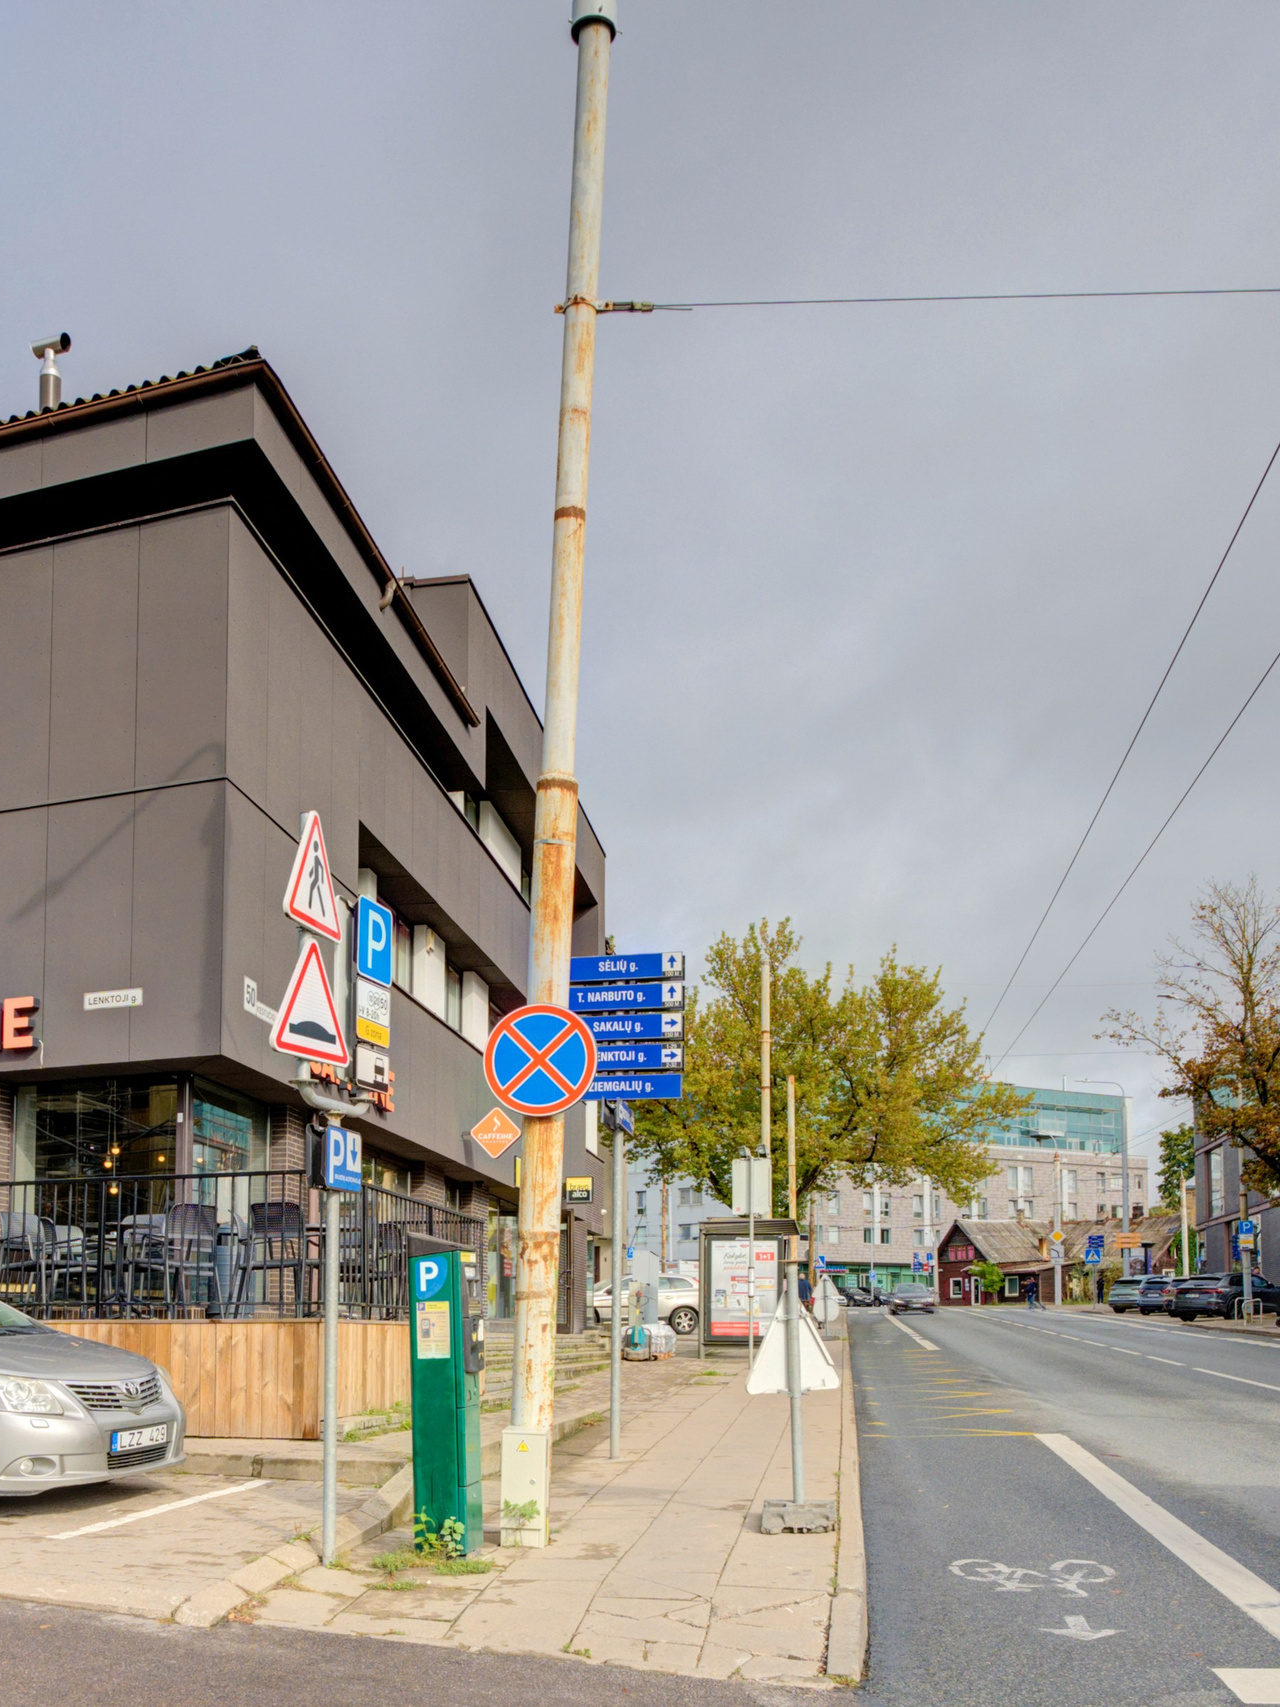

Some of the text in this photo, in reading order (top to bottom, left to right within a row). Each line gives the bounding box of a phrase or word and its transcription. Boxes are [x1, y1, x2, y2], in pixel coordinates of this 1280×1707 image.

[367, 908, 387, 969] P
[598, 959, 639, 973] SĖLIŲ g.
[88, 994, 129, 1005] LENKTOJI
[246, 984, 256, 1007] 50
[577, 990, 646, 1003] T. NARBUTO g.
[593, 1020, 644, 1033] SAKALŲ g.
[597, 1051, 647, 1062] ENKTOJI g.
[645, 1082, 654, 1092] g.
[329, 1129, 345, 1184] P
[570, 1182, 589, 1190] bravo
[572, 1190, 588, 1198] alco
[1242, 1222, 1251, 1232] P
[419, 1261, 439, 1292] P
[120, 1427, 165, 1448] LZZ 429
